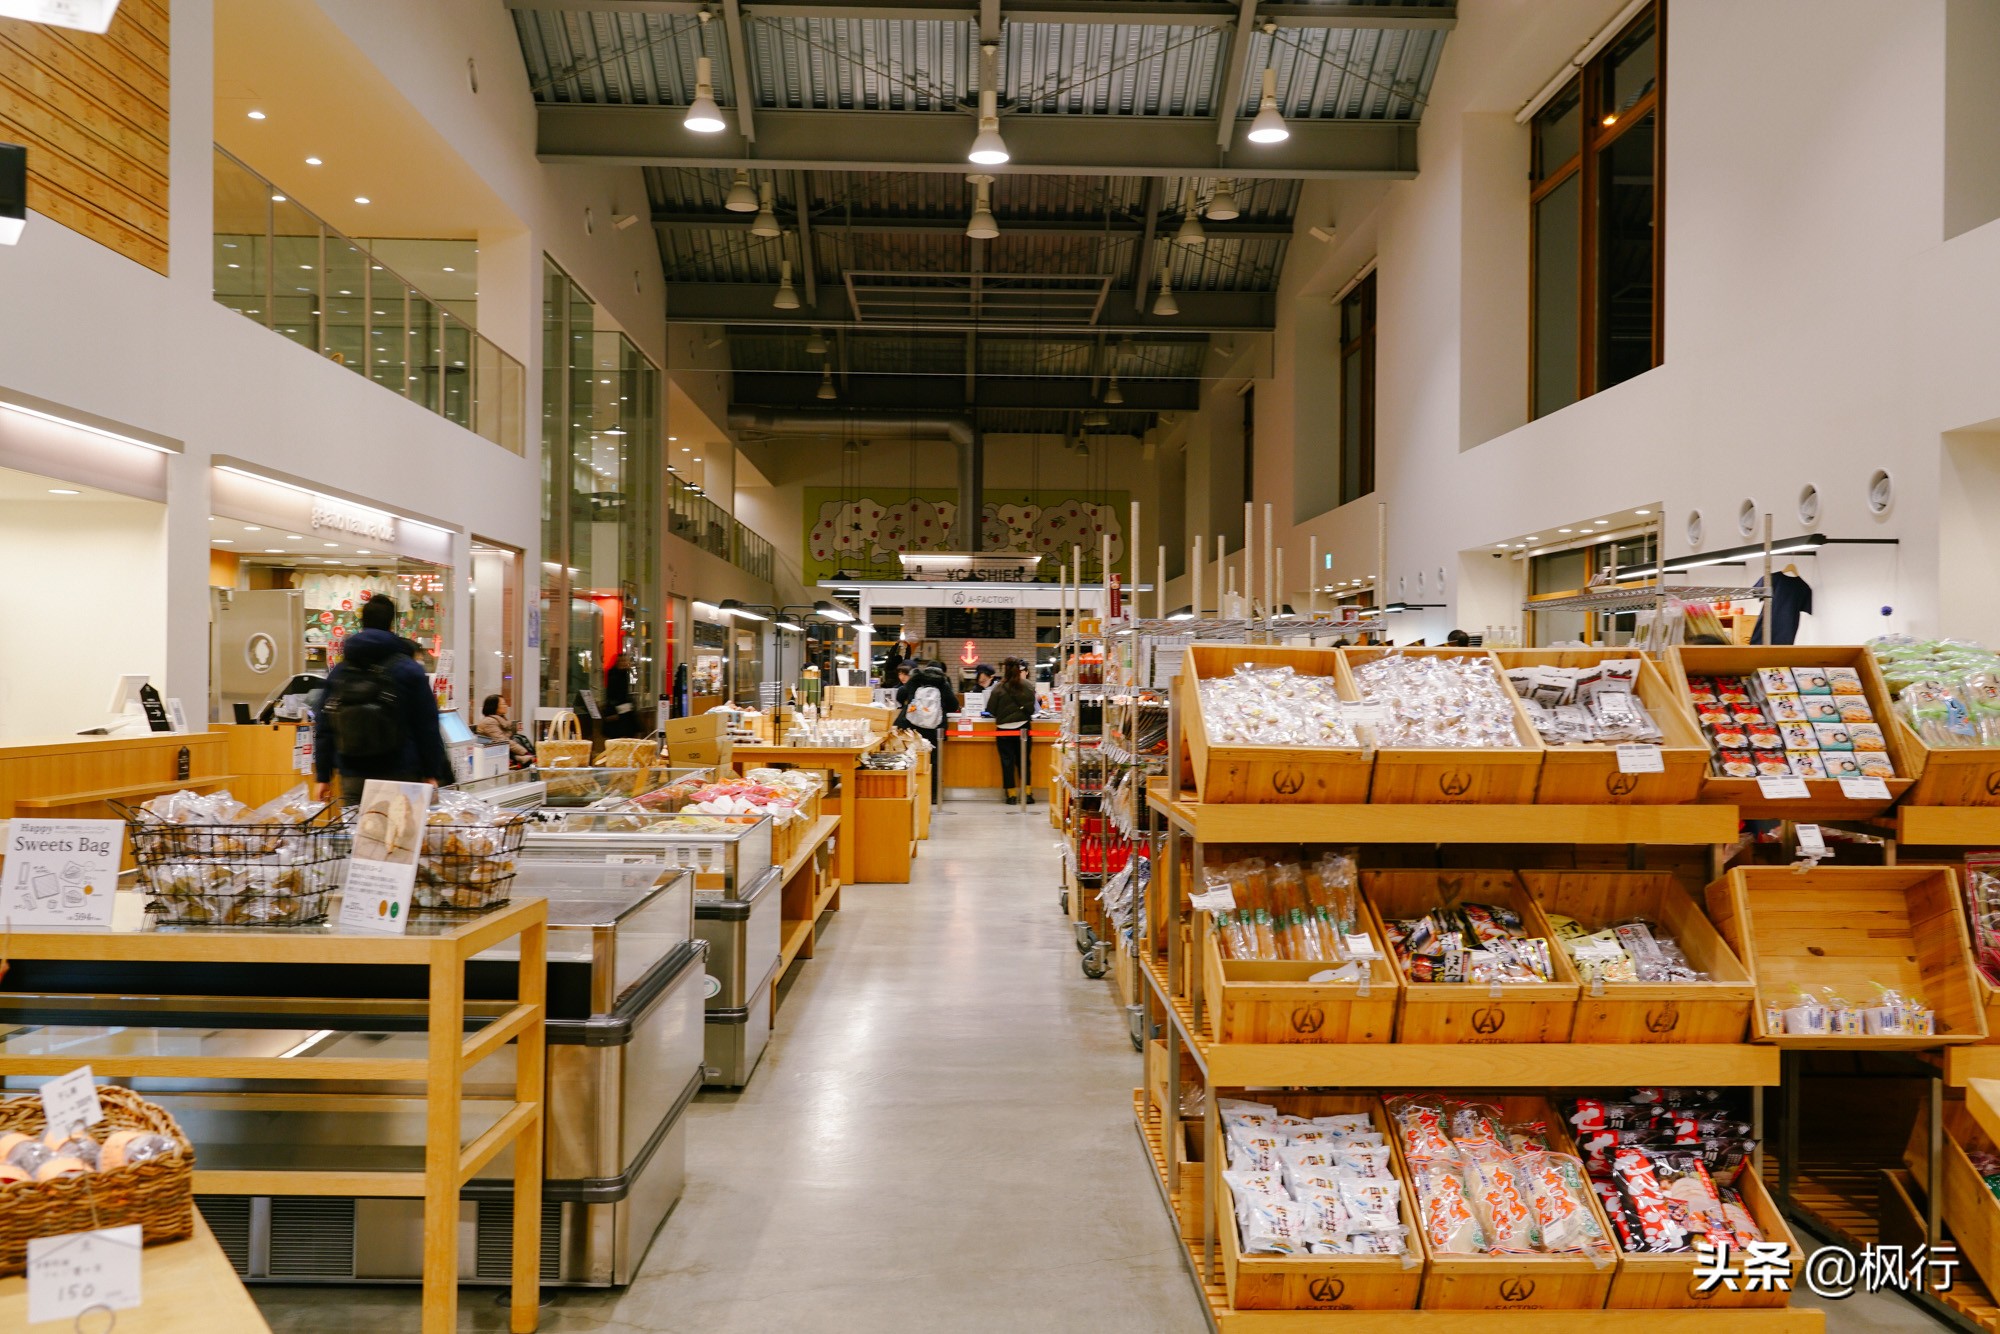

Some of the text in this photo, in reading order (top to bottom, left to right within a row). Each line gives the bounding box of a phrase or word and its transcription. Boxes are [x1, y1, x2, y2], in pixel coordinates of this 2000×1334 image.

[967, 595, 1015, 604] A-FACTORY
[20, 823, 54, 835] Happy
[14, 836, 111, 857] Sweets Bag
[58, 1284, 95, 1301] 150
